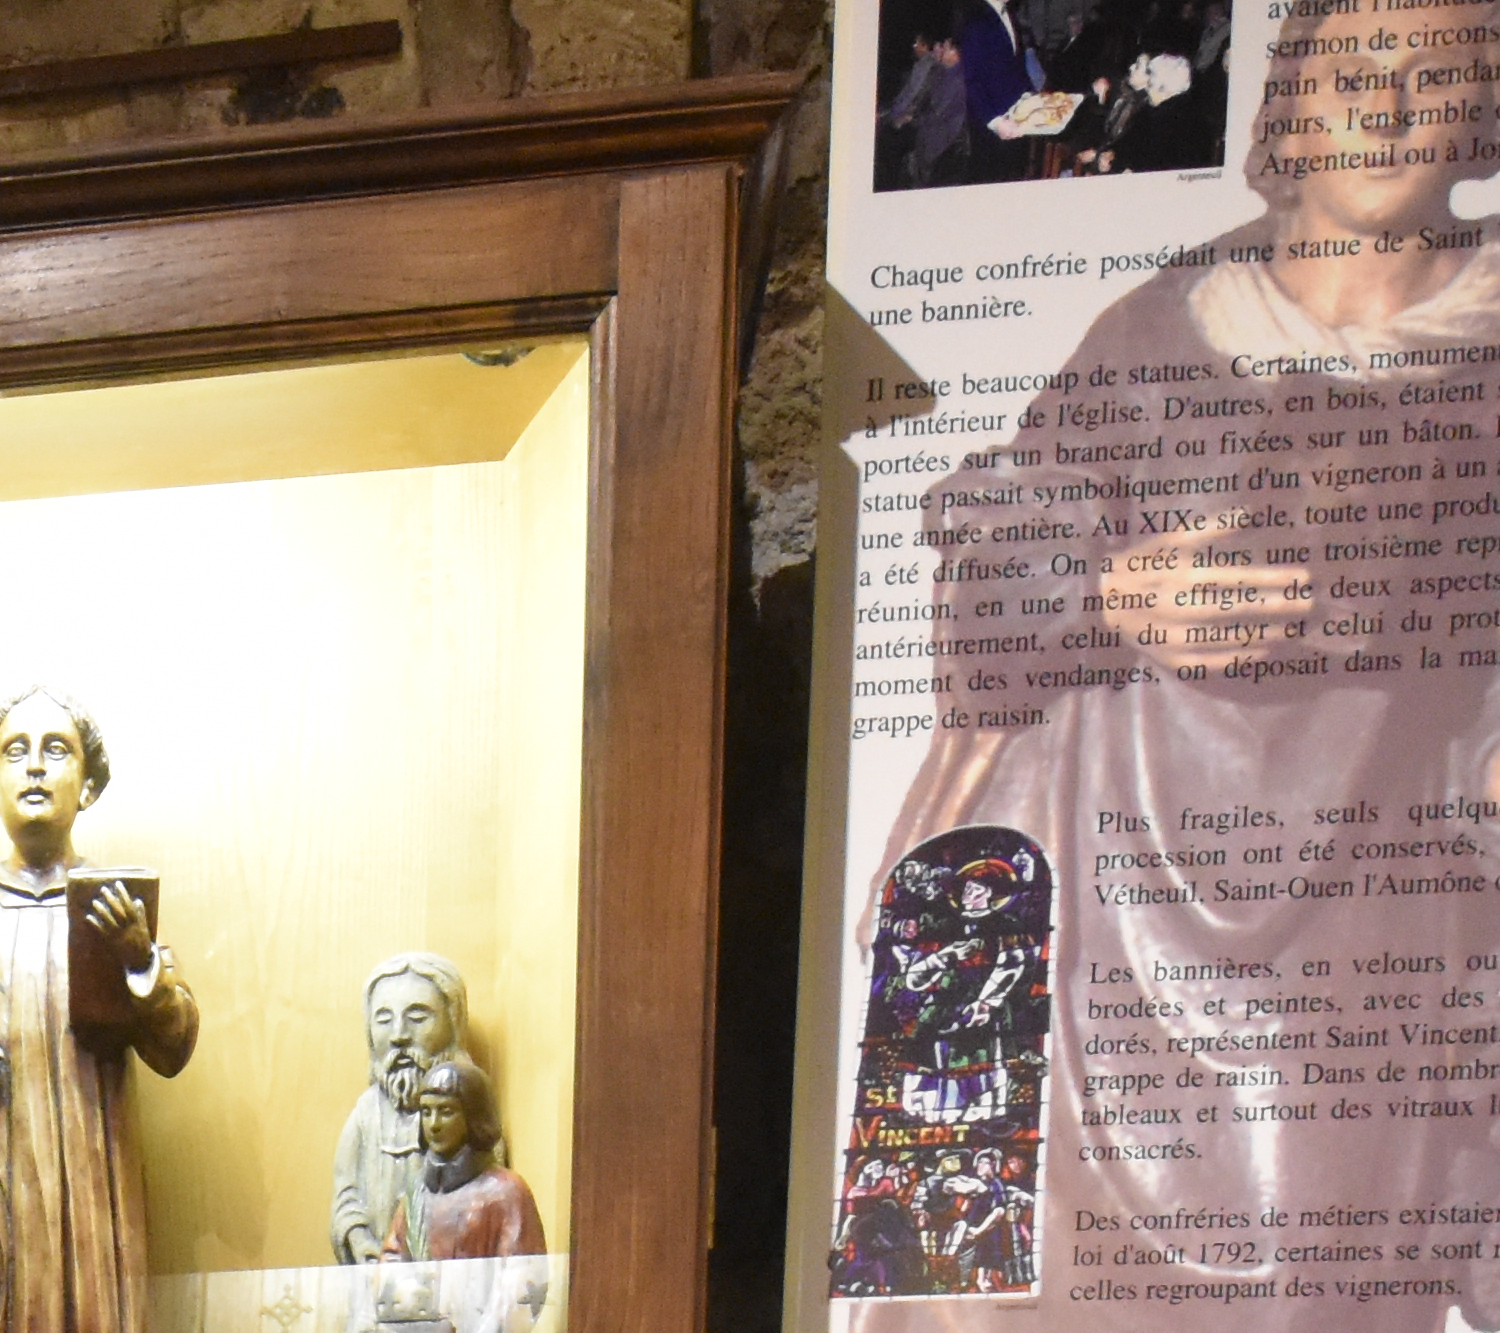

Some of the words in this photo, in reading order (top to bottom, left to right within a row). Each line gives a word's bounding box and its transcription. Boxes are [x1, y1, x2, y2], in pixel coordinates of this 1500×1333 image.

[869, 263, 963, 292] Chaque
[974, 251, 1087, 281] confrérie
[1099, 243, 1216, 280] possédait
[1229, 244, 1274, 264] une
[1287, 238, 1361, 259] statue
[1373, 230, 1403, 254] de
[1417, 224, 1482, 250] Saint
[869, 307, 912, 327] une
[921, 295, 1032, 323] bannière.
[1213, 876, 1354, 902] Saint-Ouen
[1362, 869, 1486, 897] l'Aumône
[1072, 1244, 1102, 1266] loi
[1112, 1242, 1185, 1266] d'août
[1273, 1239, 1384, 1263] certaines
[1395, 1244, 1420, 1261] se
[1430, 1240, 1482, 1260] sont
[1068, 1278, 1137, 1301] celles
[1145, 1279, 1277, 1306] regroupant
[1284, 1275, 1325, 1298] des
[1334, 1274, 1462, 1303] vignerons.
